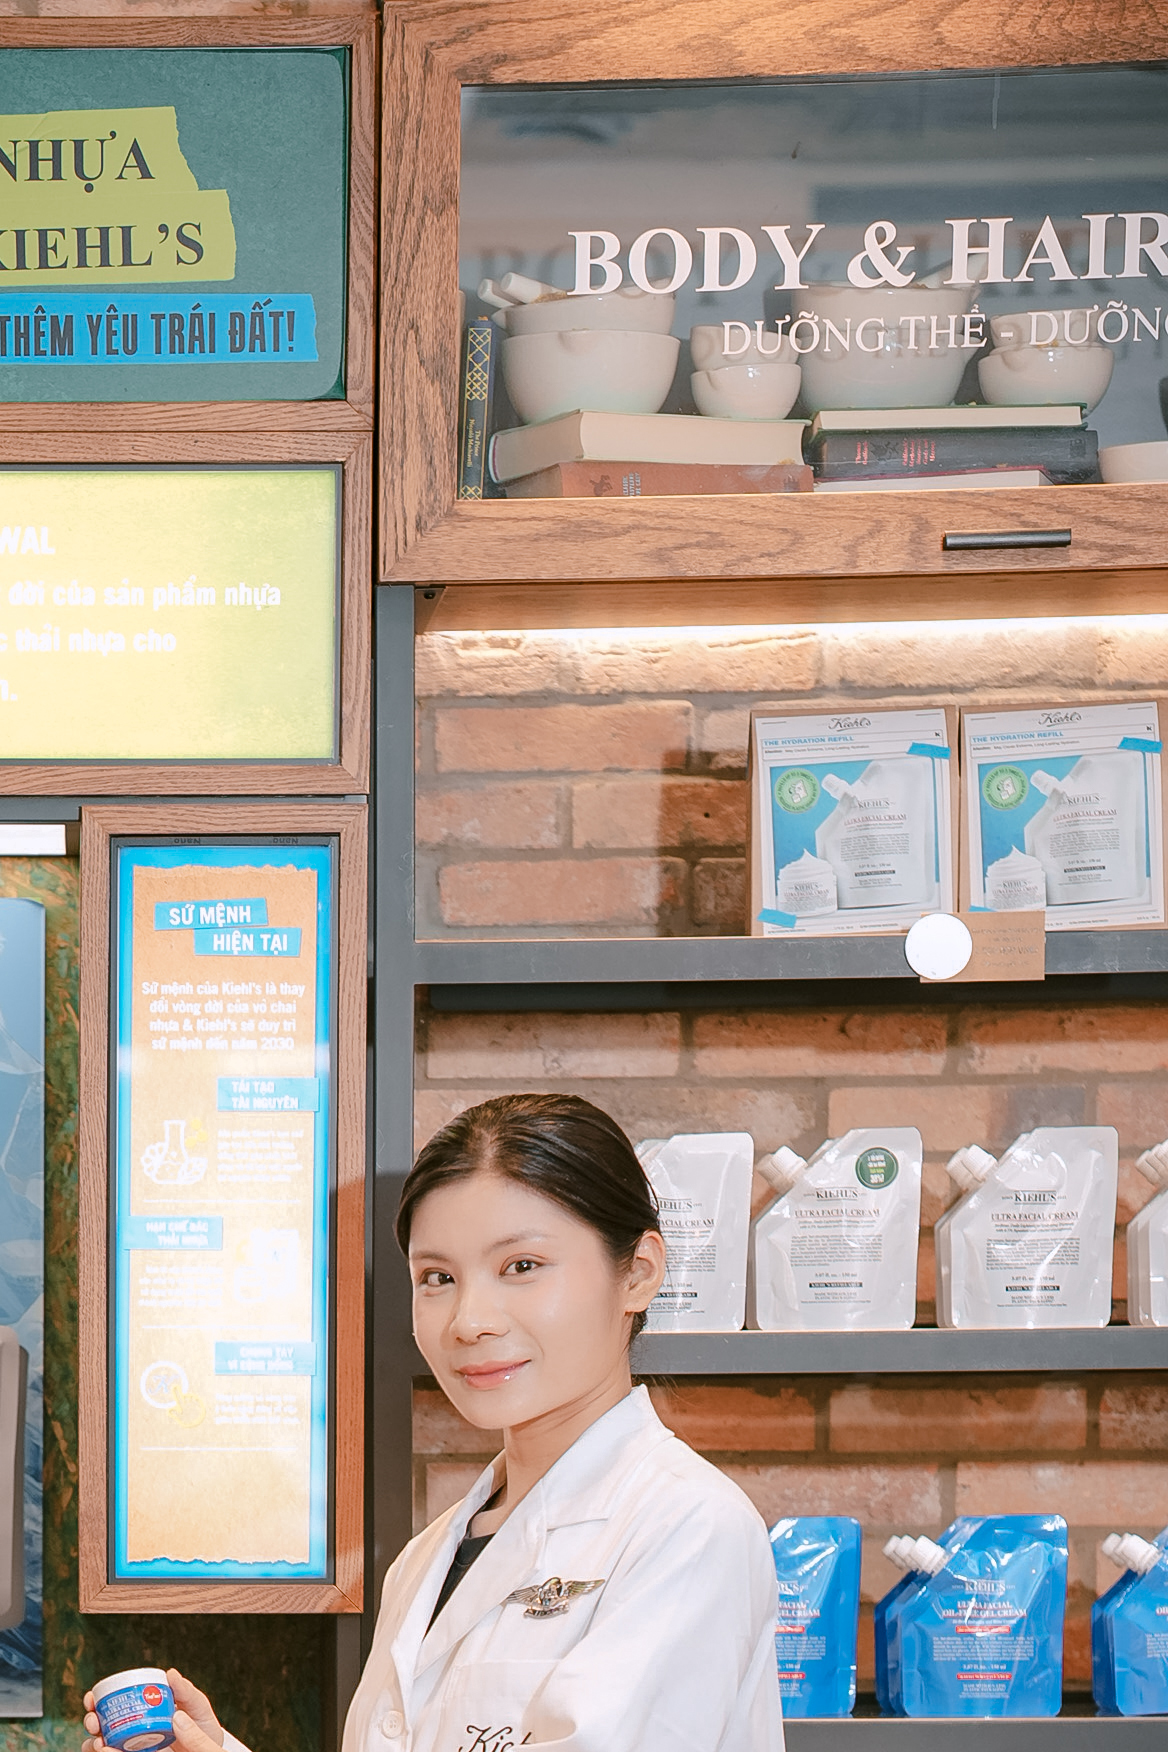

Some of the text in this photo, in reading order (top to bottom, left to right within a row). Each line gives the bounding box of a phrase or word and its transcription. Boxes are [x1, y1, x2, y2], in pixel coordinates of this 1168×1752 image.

[566, 211, 1168, 297] BODY & HAIR
[86, 303, 138, 356] YÊU
[151, 302, 217, 354] TRÁI
[228, 297, 296, 354] ĐẤT!
[721, 300, 1168, 356] DƯỠNG THỂ DƯỠN
[9, 580, 46, 605] đời
[53, 580, 96, 606] của
[104, 577, 145, 606] sản
[153, 574, 217, 611] phẩm
[225, 582, 282, 611] nhựa
[16, 623, 61, 652] thải
[69, 628, 126, 657] nhựa
[133, 629, 177, 652] cho
[169, 902, 251, 928] SỨ MỆNH
[213, 929, 288, 955] HIỆN TẠI
[161, 982, 193, 997] mệnh
[197, 981, 219, 995] của
[222, 982, 262, 995] Kiehl's
[265, 982, 277, 995] là
[280, 982, 306, 998] thay
[270, 1000, 297, 1013] chai
